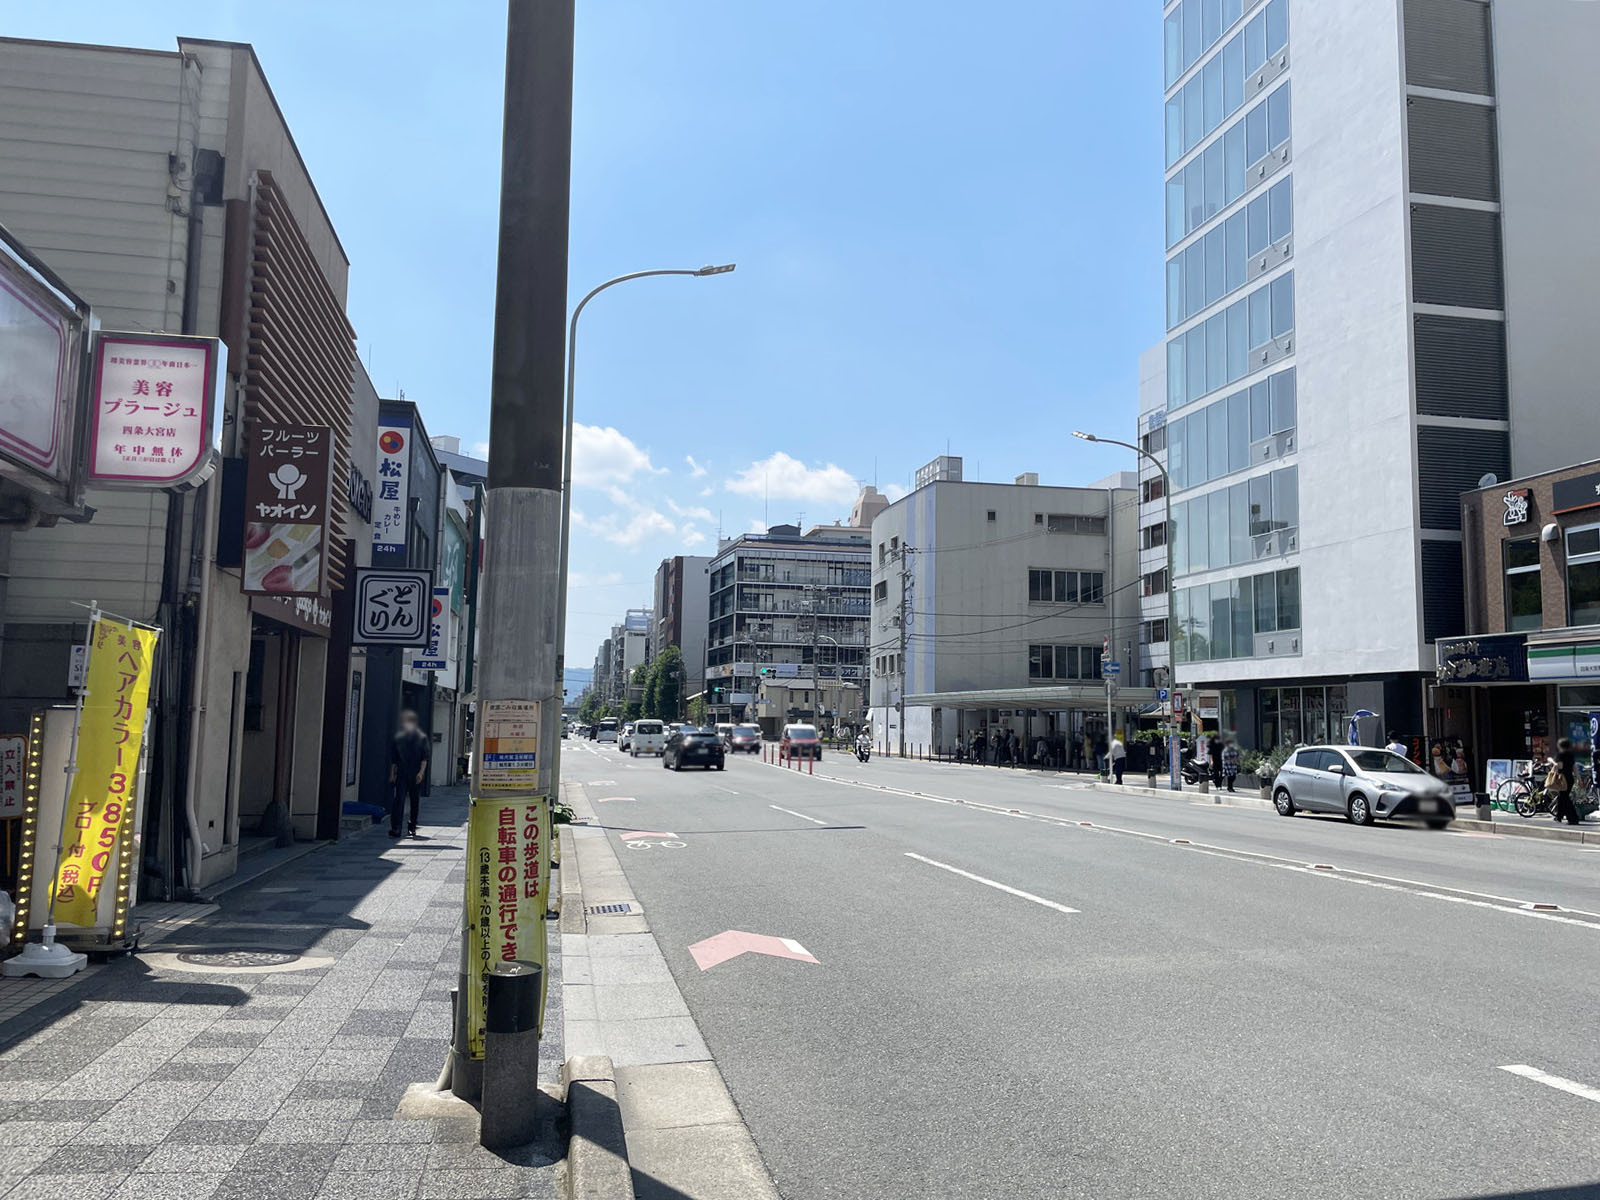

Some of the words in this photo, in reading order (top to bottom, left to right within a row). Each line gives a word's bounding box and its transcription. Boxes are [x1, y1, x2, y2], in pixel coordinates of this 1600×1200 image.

[132, 379, 173, 397] 美容
[104, 398, 198, 417] プラージュ
[122, 426, 177, 437] 四条大宮店
[262, 429, 319, 443] フルーツ
[114, 444, 183, 457] 年中無休
[260, 444, 319, 458] パーラー
[379, 458, 402, 500] 松屋
[383, 514, 392, 534] カレー
[1160, 691, 1166, 699] P
[523, 805, 539, 899] この歩道は
[497, 807, 518, 961] 自転車の通行でき
